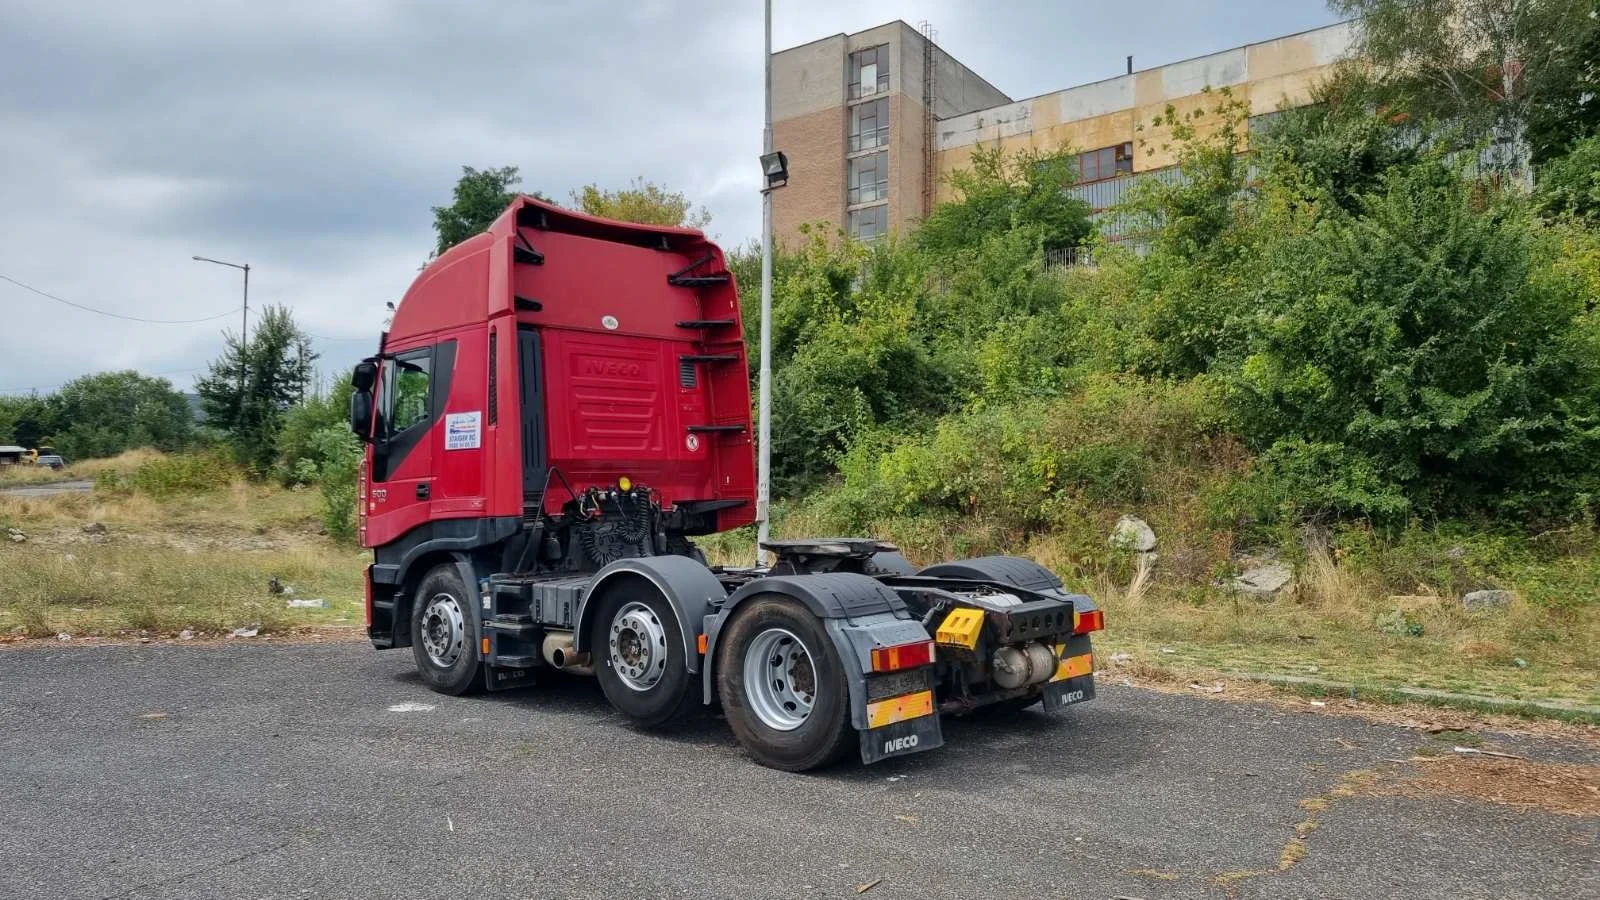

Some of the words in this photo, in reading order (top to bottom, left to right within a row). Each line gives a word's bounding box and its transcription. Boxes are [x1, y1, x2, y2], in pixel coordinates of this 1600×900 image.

[585, 360, 641, 377] IVECO
[371, 489, 387, 498] 500
[1062, 689, 1083, 705] IVECO
[884, 734, 919, 753] IVECO
